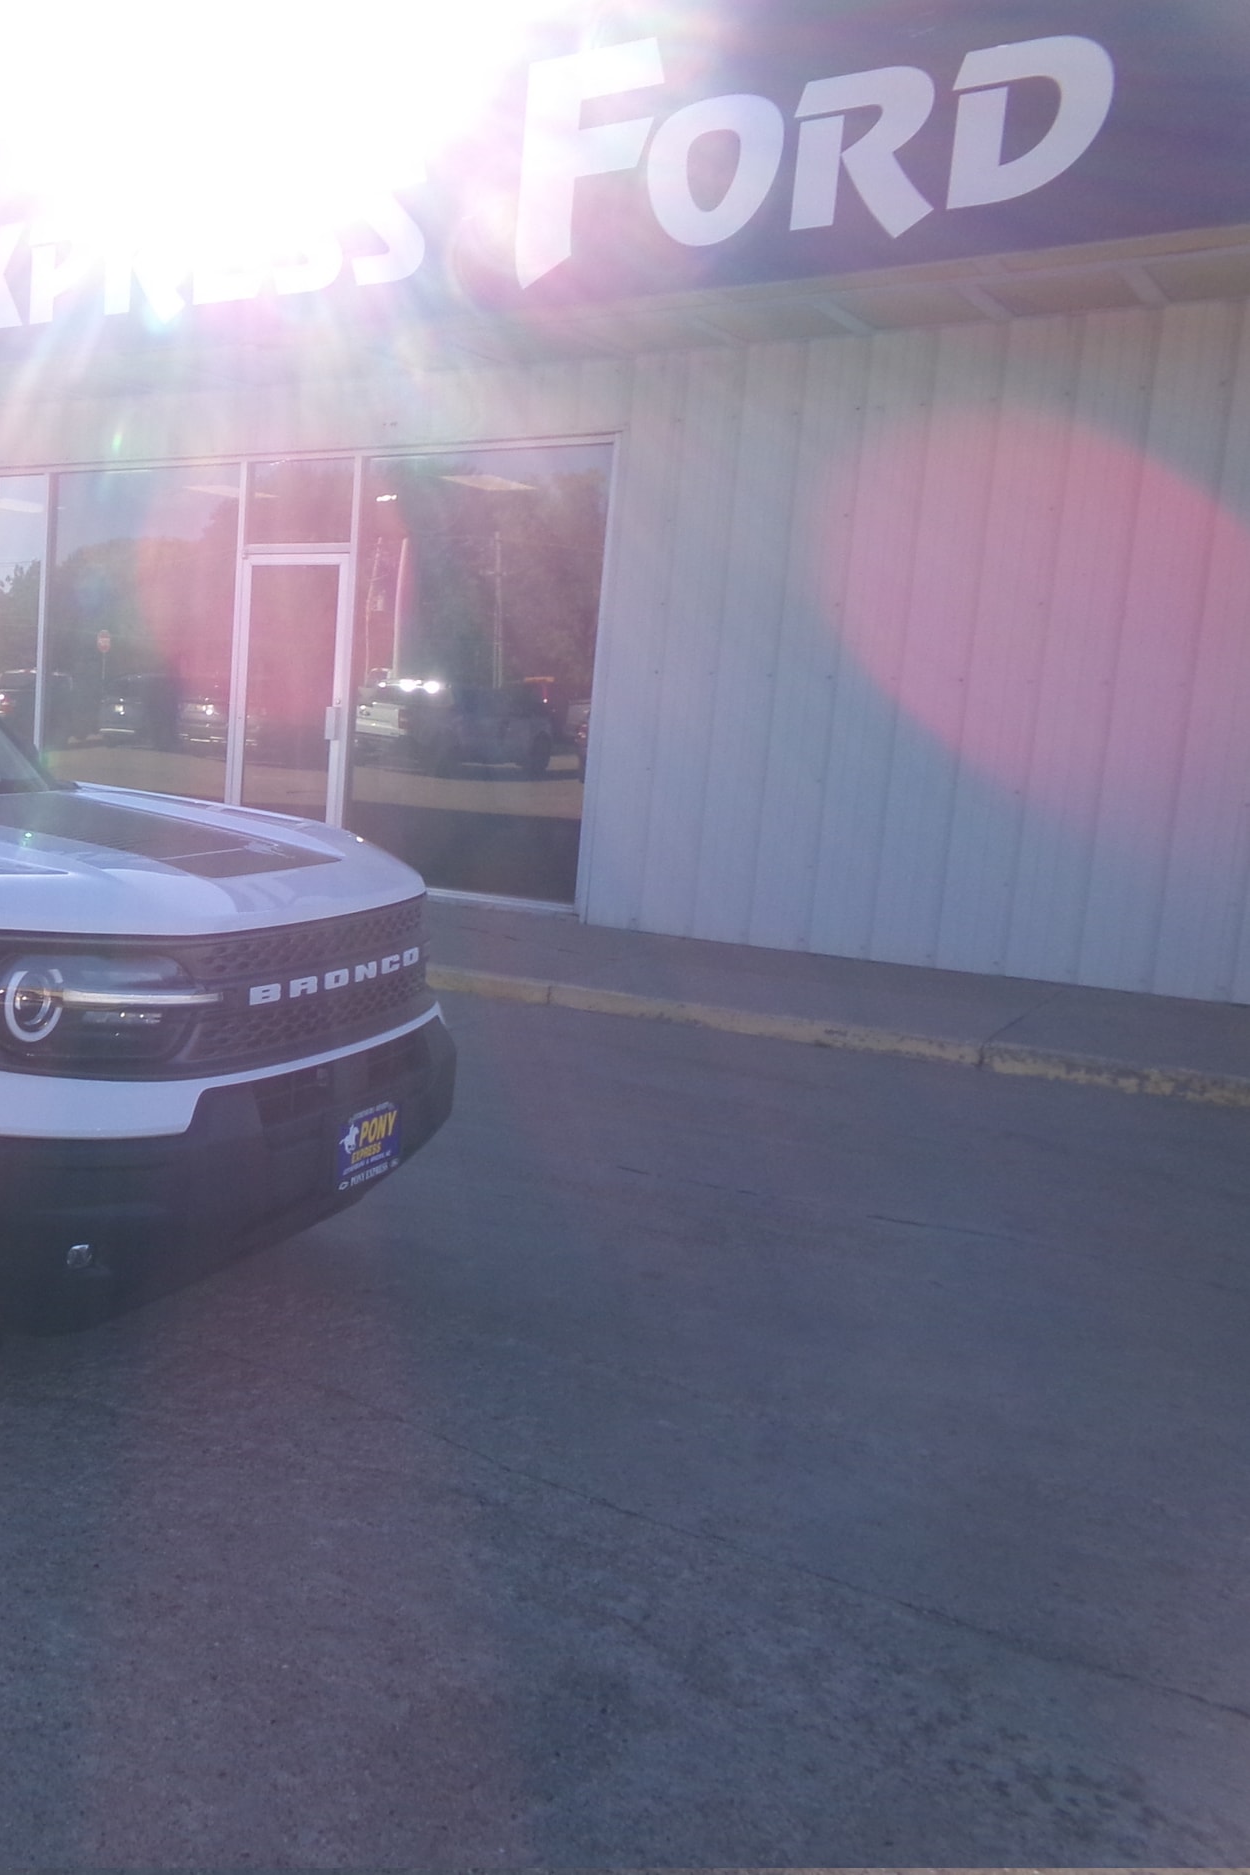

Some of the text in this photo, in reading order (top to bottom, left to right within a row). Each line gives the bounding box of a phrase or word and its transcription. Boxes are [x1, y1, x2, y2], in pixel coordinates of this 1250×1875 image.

[515, 35, 1114, 290] FORD
[249, 947, 419, 1006] BRONCO
[351, 1141, 381, 1164] EXPRESS
[358, 1110, 397, 1147] PONY
